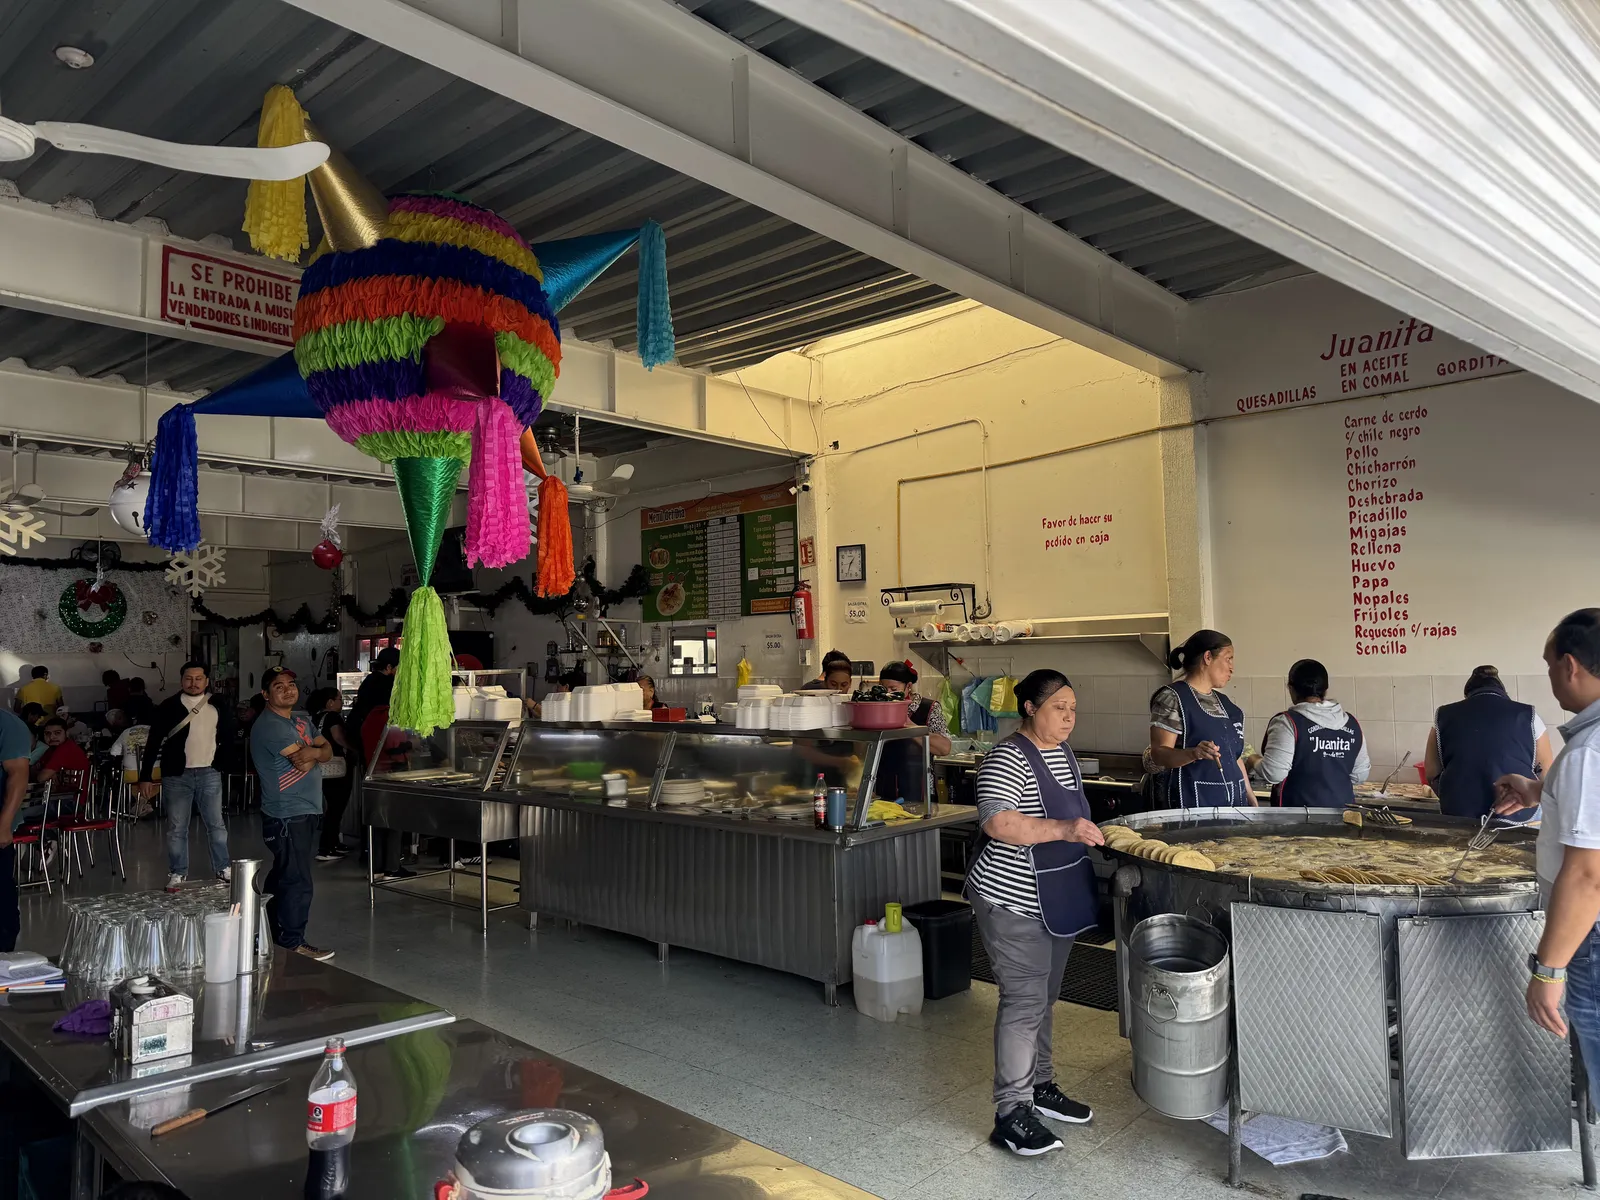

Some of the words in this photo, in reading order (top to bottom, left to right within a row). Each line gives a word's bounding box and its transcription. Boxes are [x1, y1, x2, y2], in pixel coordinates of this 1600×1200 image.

[191, 263, 213, 284] SE
[223, 270, 292, 302] PROHIBE
[170, 281, 185, 296] LA
[194, 287, 250, 311] ENTRADA
[254, 301, 262, 314] A
[169, 299, 241, 326] VENDEDORES
[244, 316, 249, 328] E
[1320, 317, 1435, 361] Juanita
[1340, 363, 1356, 377] EN
[1363, 353, 1409, 374] ACEITE
[1341, 379, 1357, 393] EN
[1363, 370, 1410, 389] COMAL
[1236, 385, 1317, 412] QUESADILLAS
[1344, 415, 1377, 429] Carne
[1382, 410, 1395, 424] de
[1399, 406, 1428, 421] cerdo
[1345, 431, 1355, 445] c/
[1358, 428, 1384, 444] chile
[1389, 425, 1421, 440] negro
[1345, 444, 1379, 460] Pollo
[1347, 456, 1417, 476] Chicharrón
[1348, 476, 1398, 492] Chorizo
[1348, 488, 1424, 508] Deshebrada
[1042, 518, 1066, 529] Favor
[1068, 515, 1077, 527] de
[1079, 514, 1101, 525] hacer
[1104, 514, 1112, 523] su
[1349, 506, 1408, 524] Picadillo
[1045, 535, 1072, 551] pedido
[1075, 536, 1085, 545] en
[1089, 530, 1109, 545] caja
[1350, 524, 1407, 541] Migajas
[1350, 541, 1402, 556] Rellena
[1351, 559, 1396, 573] Huevo
[1352, 575, 1389, 592] Papa
[1353, 591, 1410, 608] Nopales
[1353, 607, 1409, 624] Frijoles
[1355, 623, 1406, 640] Requesón
[1423, 623, 1457, 640] rajas
[1356, 641, 1407, 656] Sencilla
